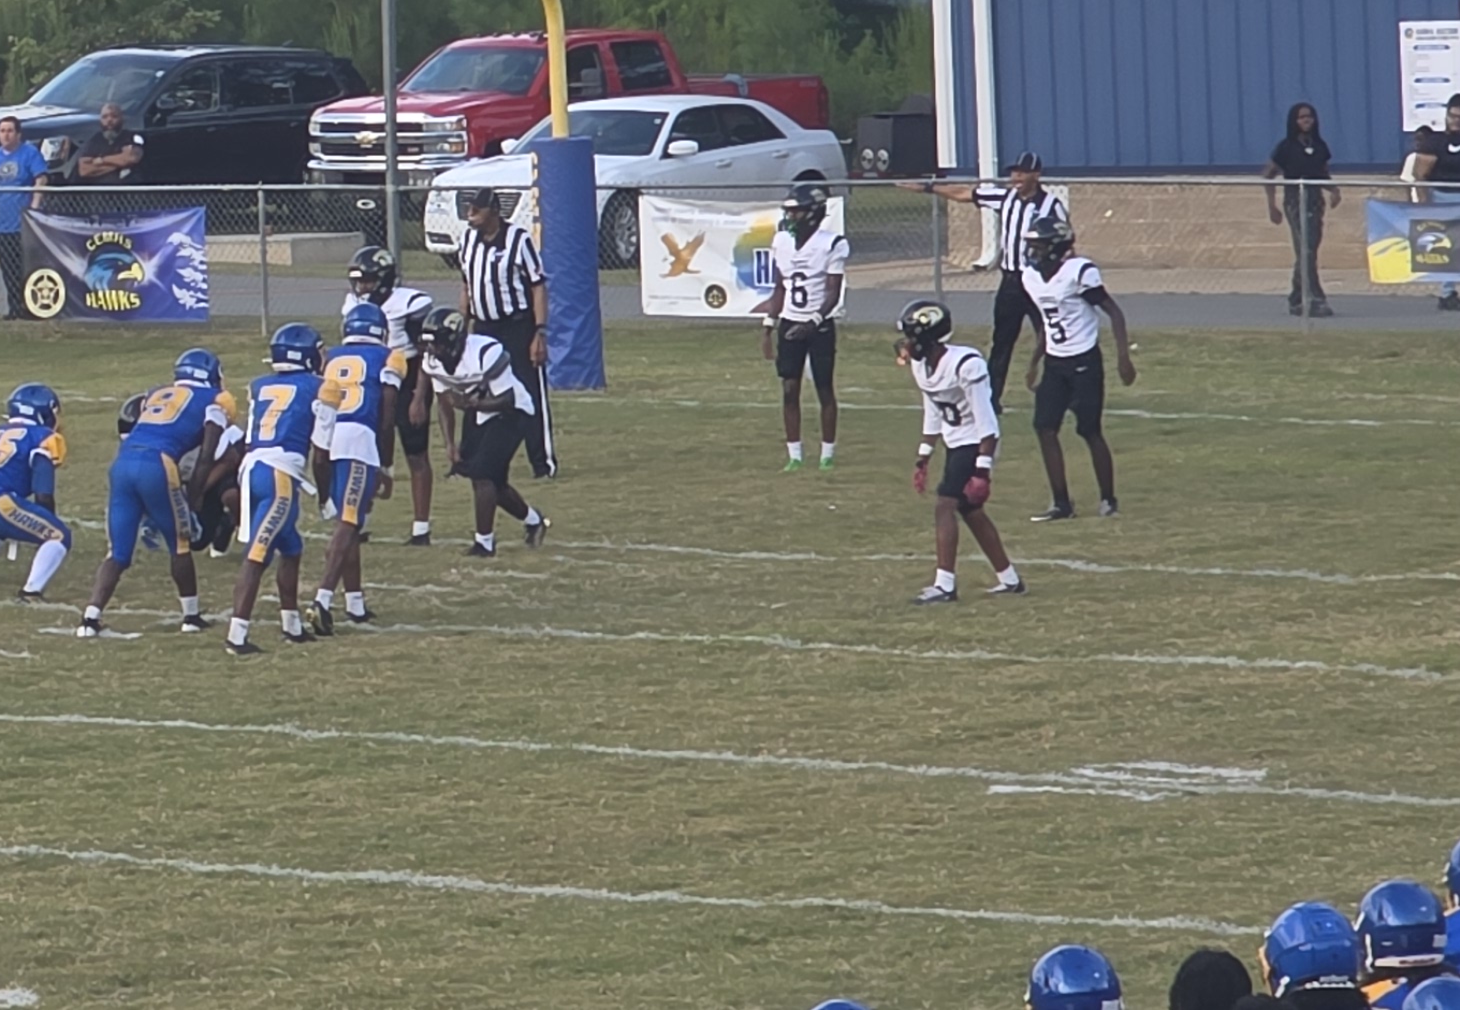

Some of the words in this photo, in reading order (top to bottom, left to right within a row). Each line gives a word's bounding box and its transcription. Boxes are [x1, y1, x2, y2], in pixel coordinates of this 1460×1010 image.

[85, 289, 141, 311] HAWKS
[323, 355, 368, 415] 8
[258, 384, 298, 441] 7
[9, 508, 56, 540] HAWKS
[257, 495, 290, 546] HAWKS
